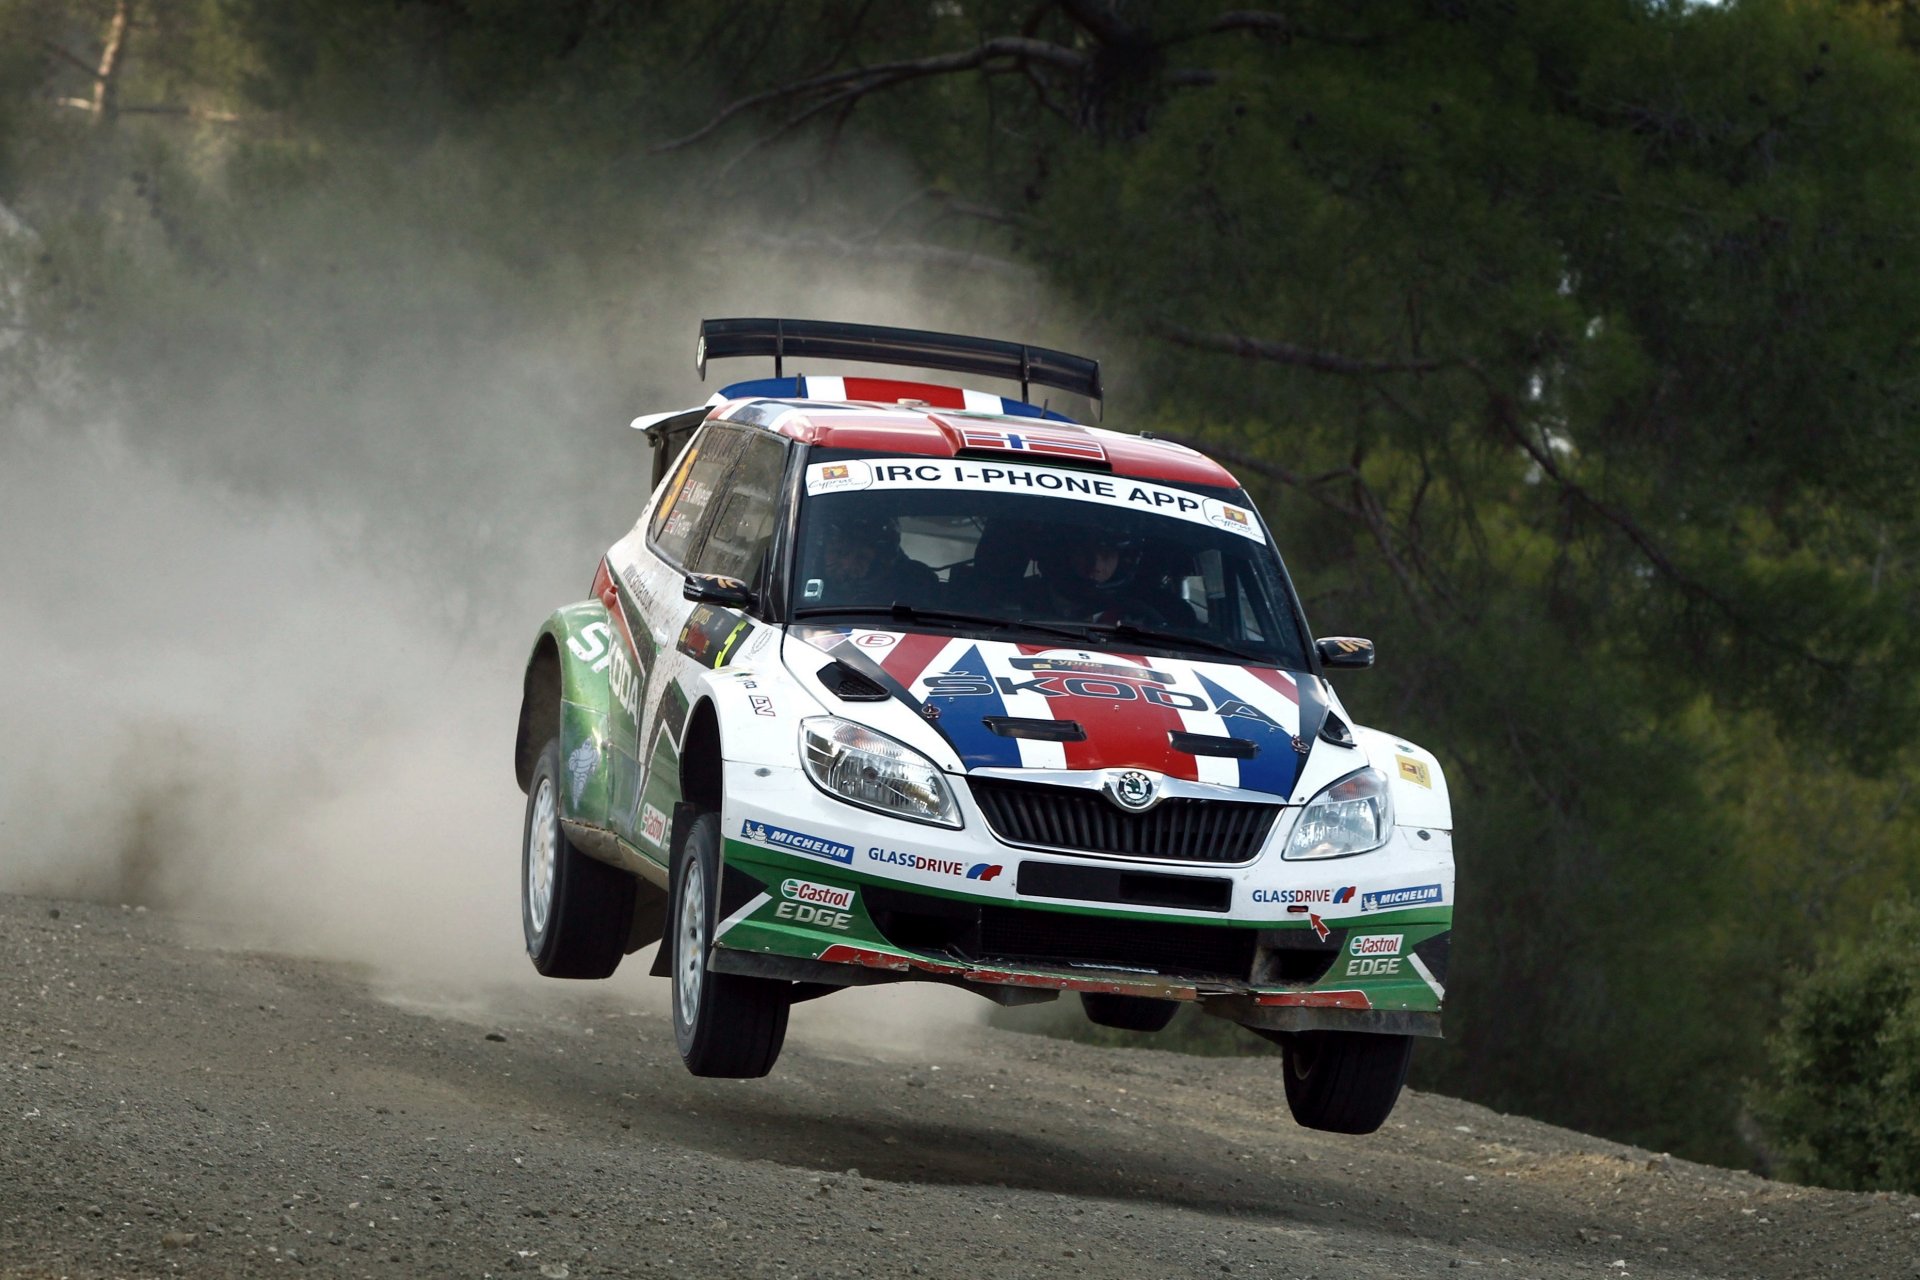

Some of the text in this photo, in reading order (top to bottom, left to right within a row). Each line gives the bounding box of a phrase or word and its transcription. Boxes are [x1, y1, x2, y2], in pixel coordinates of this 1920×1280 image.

[874, 465, 1199, 514] IRC I-PHONE APP
[1077, 652, 1092, 660] 5
[770, 830, 850, 858] MICHELIN
[868, 847, 963, 876] GLASSDRIVE
[798, 882, 850, 908] Castrol
[1252, 889, 1331, 903] GLASSDRIVE
[1379, 887, 1439, 905] MICHELIN
[774, 901, 853, 930] EDGE
[1361, 937, 1400, 954] Castrol
[1346, 958, 1403, 976] EDGE
